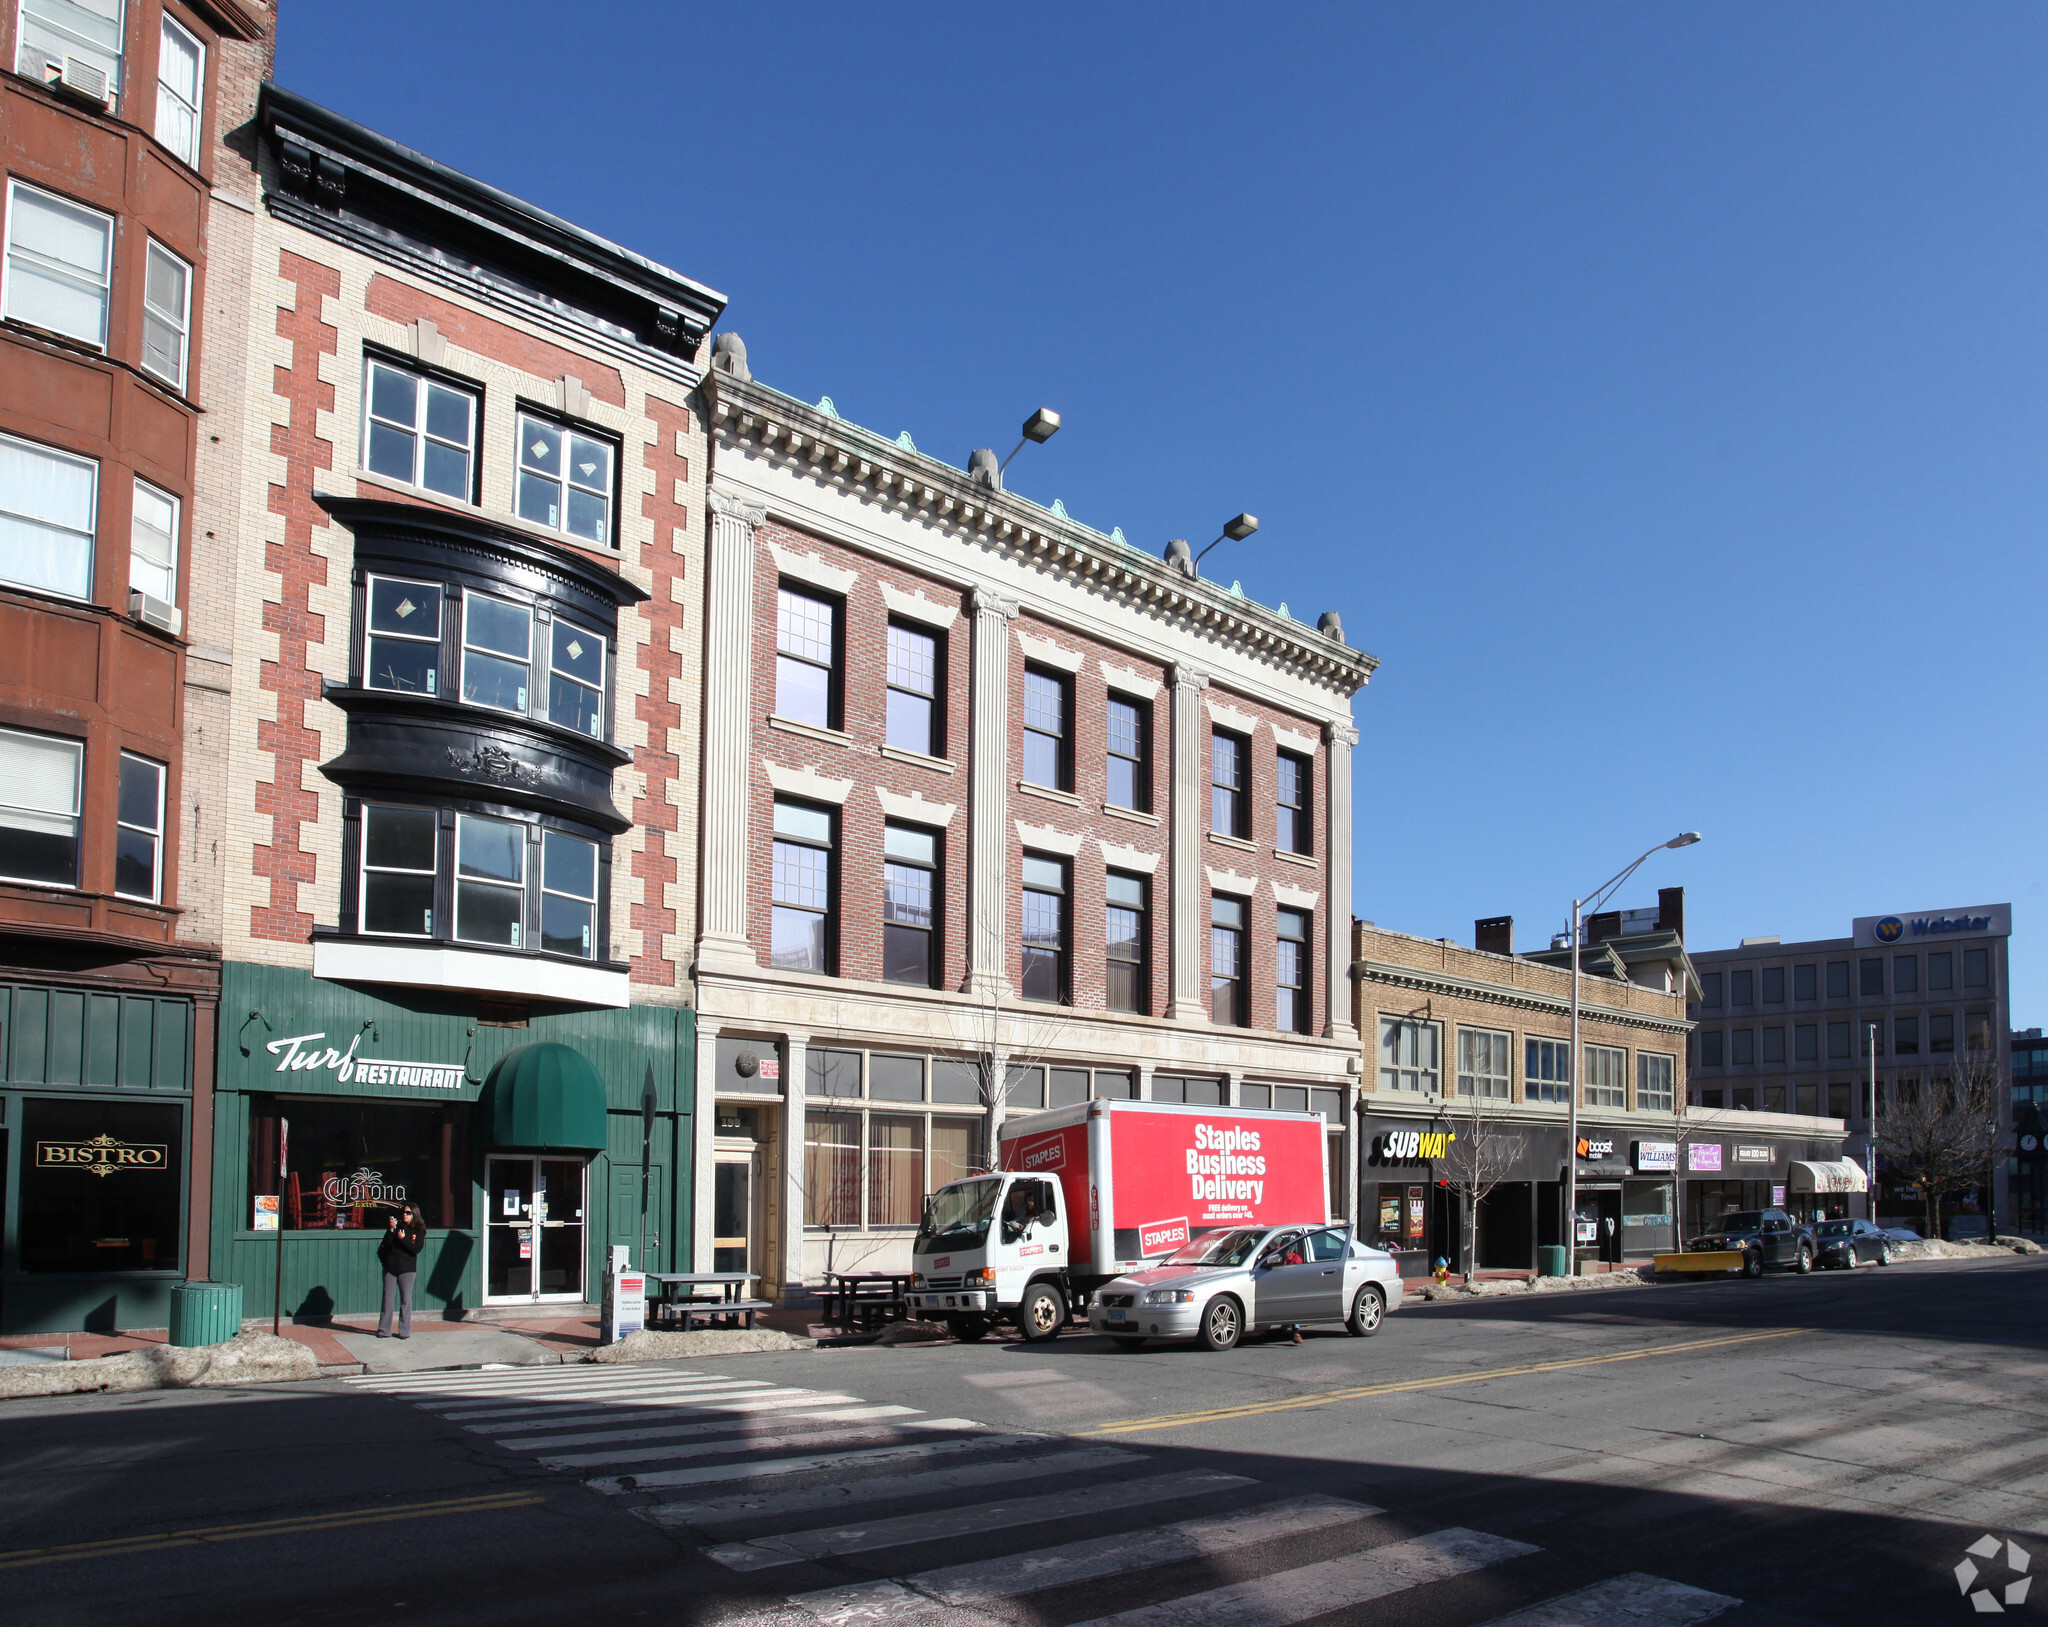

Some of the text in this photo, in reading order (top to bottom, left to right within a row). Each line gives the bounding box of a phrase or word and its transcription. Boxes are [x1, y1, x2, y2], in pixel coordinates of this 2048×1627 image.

[1911, 914, 1991, 936] Webster
[266, 1032, 361, 1083] Turf
[354, 1065, 465, 1089] RESTAURANT
[1195, 1123, 1261, 1155] Staples
[1383, 1131, 1456, 1159] SUBWAY
[1589, 1139, 1613, 1153] boost
[1641, 1143, 1656, 1153] Mike
[43, 1146, 162, 1164] BISTRO
[1025, 1145, 1060, 1169] STAPLES
[1186, 1148, 1267, 1175] Business
[1640, 1152, 1676, 1162] WILLIAMS
[323, 1177, 407, 1205] Corona
[1192, 1174, 1264, 1205] Delivery
[1900, 1193, 1917, 1201] find
[355, 1200, 377, 1208] Extra
[1208, 1204, 1221, 1212] FREE
[1221, 1204, 1241, 1212] delivery
[1145, 1227, 1185, 1246] STAPLES
[1020, 1246, 1043, 1256] STAPLES
